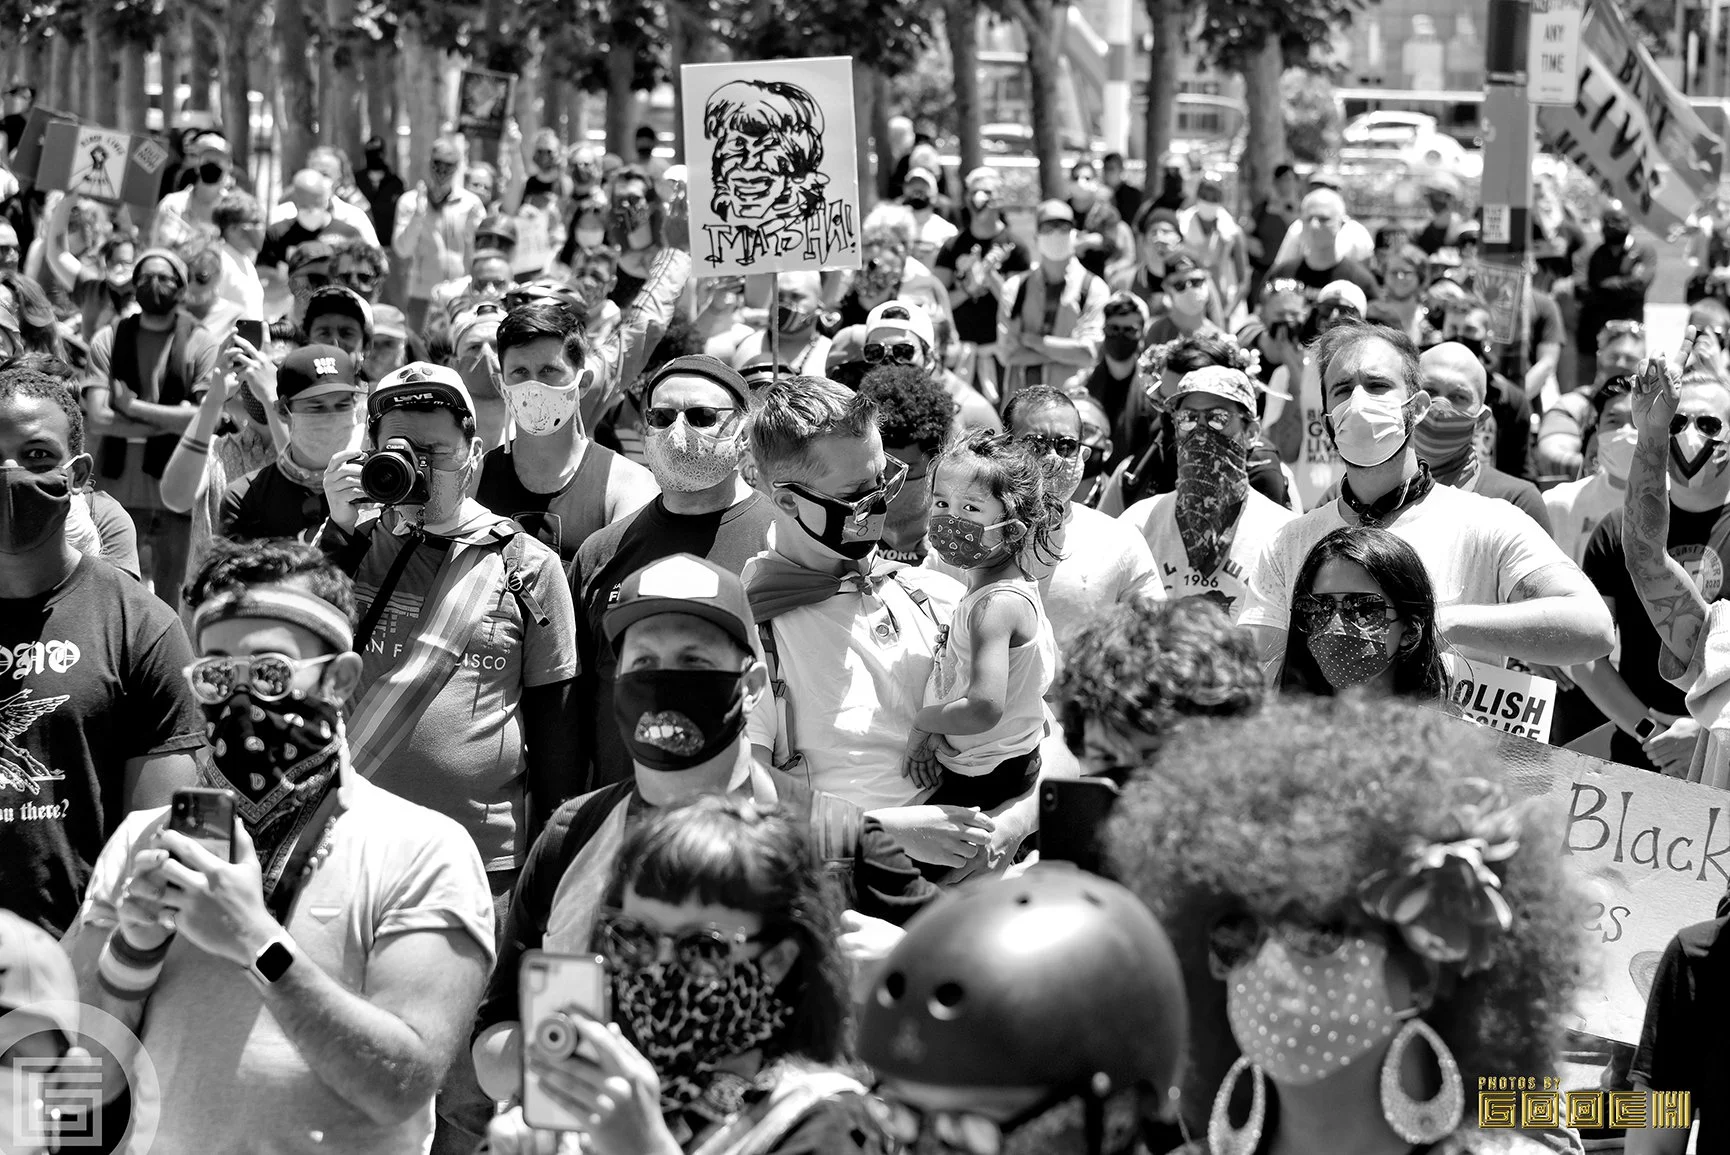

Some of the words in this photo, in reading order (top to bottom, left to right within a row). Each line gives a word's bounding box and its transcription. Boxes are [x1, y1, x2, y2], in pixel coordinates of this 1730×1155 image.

[1543, 24, 1565, 41] ANY
[1541, 53, 1564, 73] TIME
[702, 199, 856, 268] MARSHA!
[879, 549, 919, 561] YORK
[1184, 574, 1219, 588] 1966
[1453, 679, 1546, 726] OLISH
[20, 798, 70, 821] there?
[1560, 782, 1730, 882] Black
